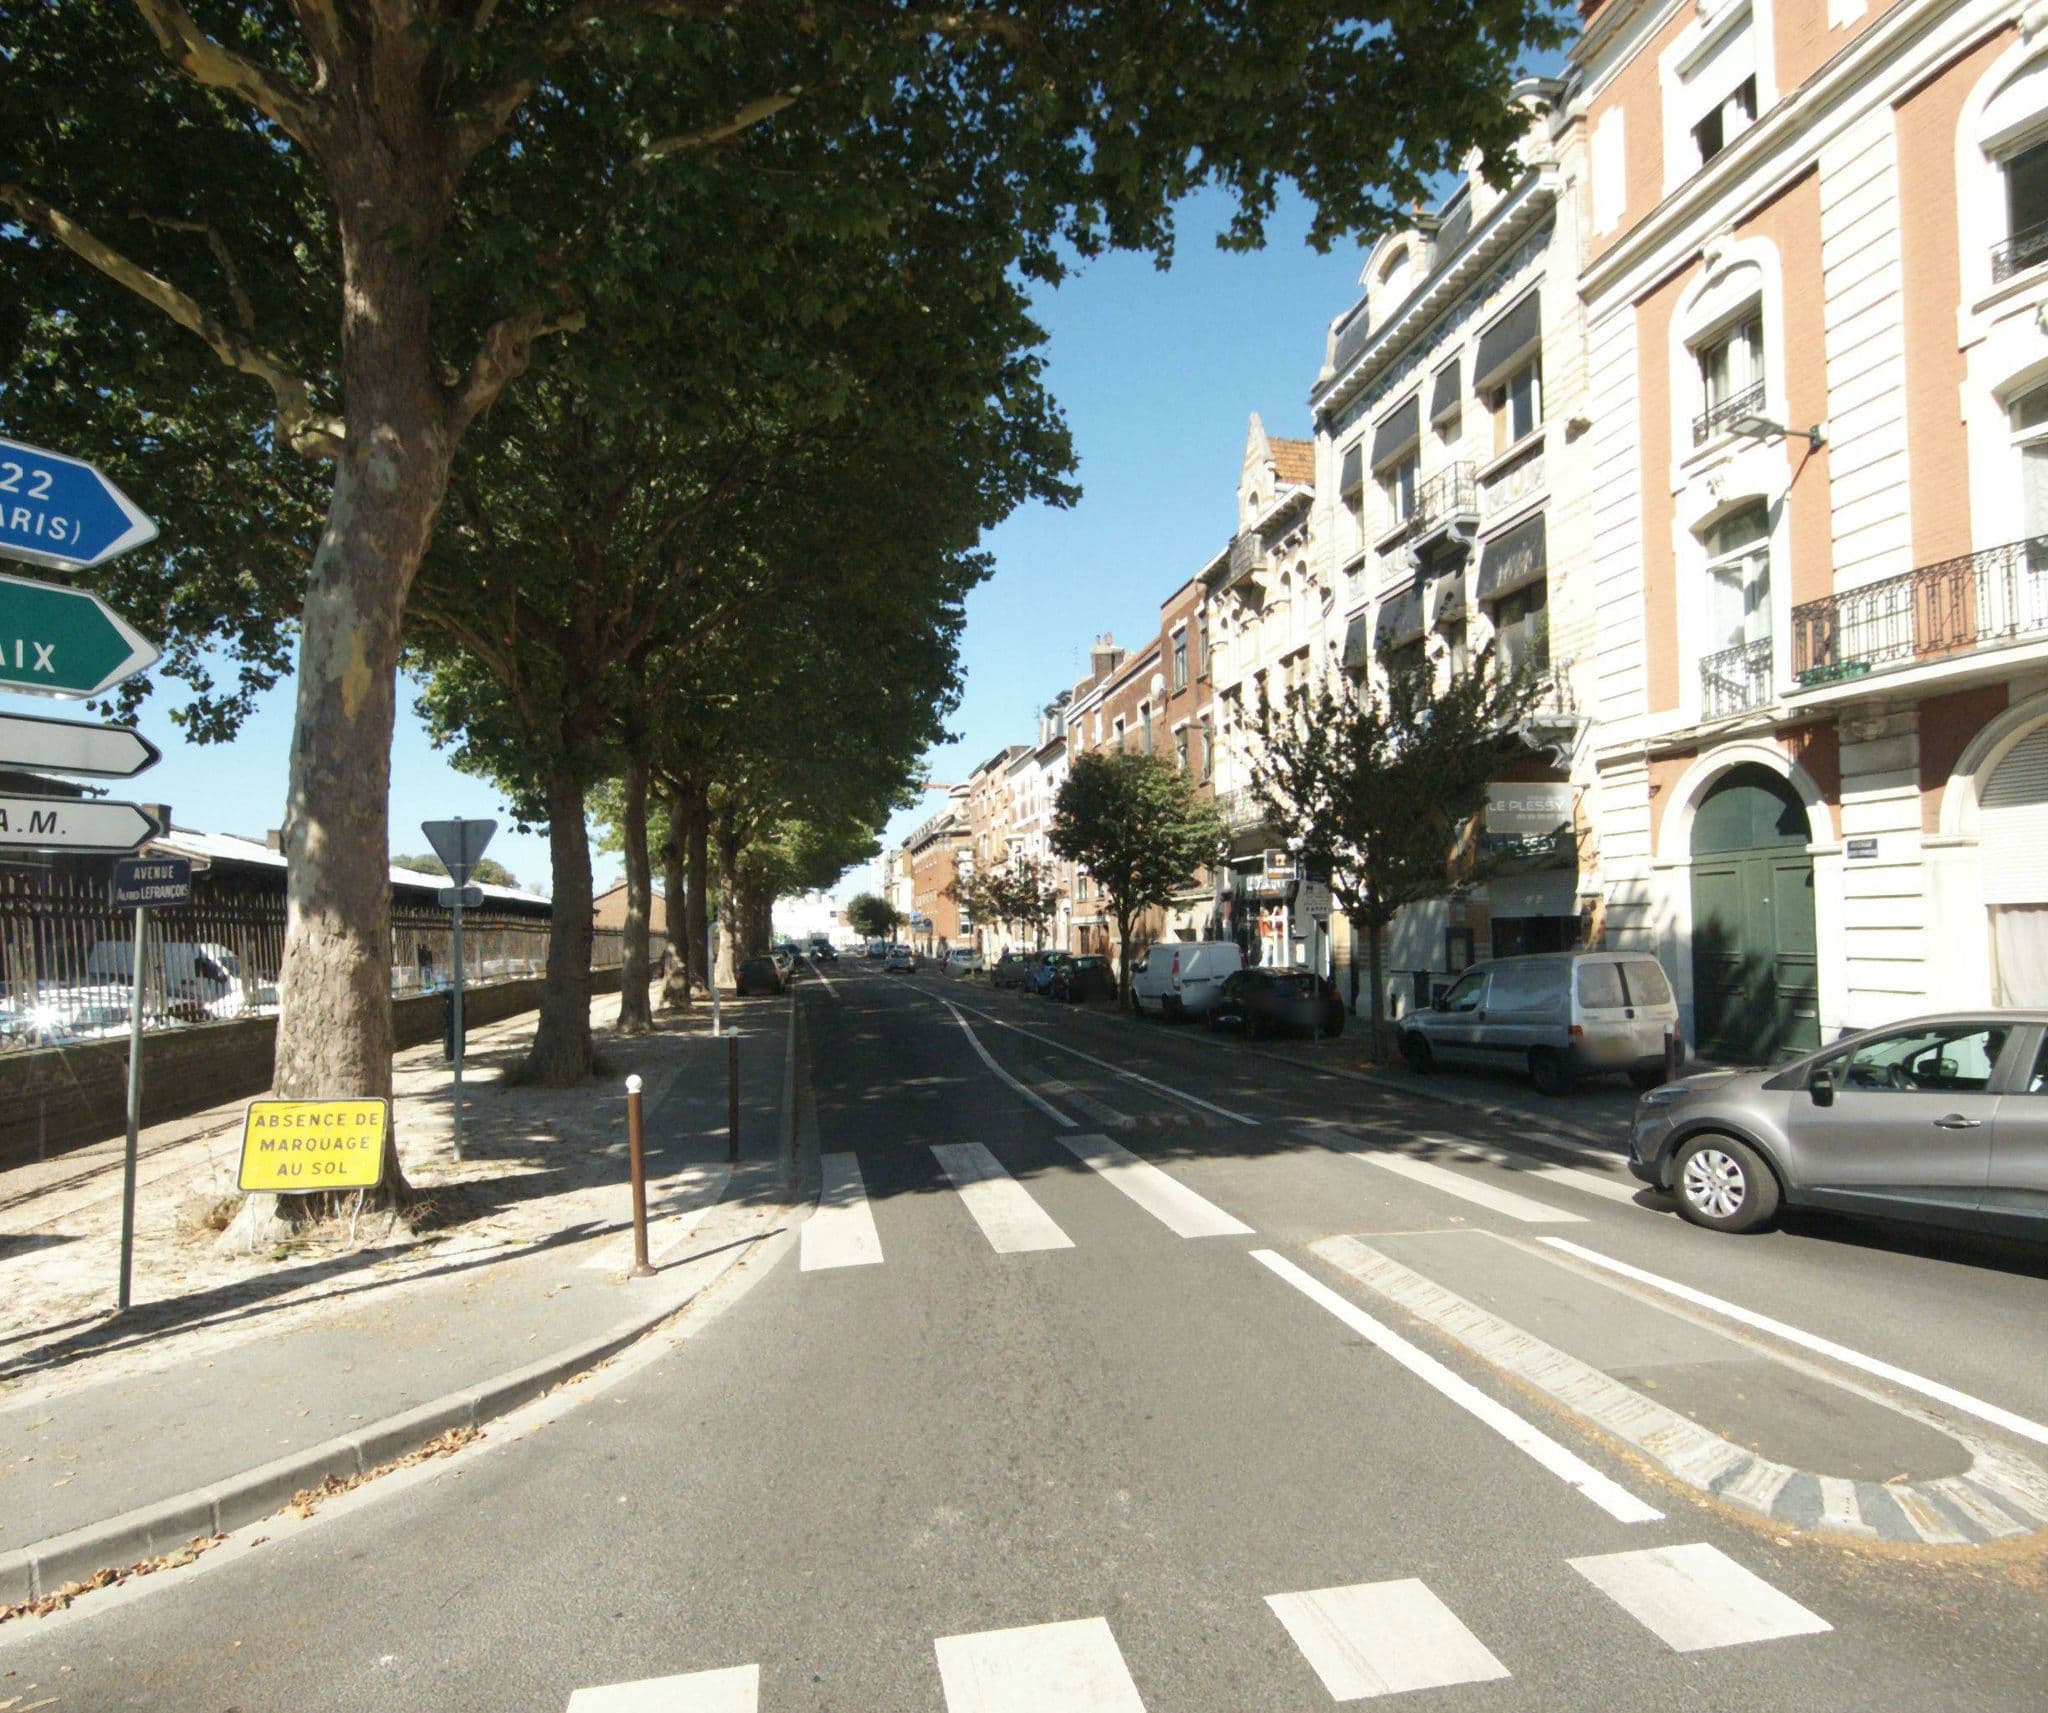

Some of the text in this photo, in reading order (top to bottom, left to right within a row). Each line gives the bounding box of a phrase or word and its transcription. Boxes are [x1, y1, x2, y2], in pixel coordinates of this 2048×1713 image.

[1489, 800, 1506, 811] LE
[133, 865, 174, 880] AVENUE
[255, 1112, 379, 1128] ABSENCE DE
[260, 1136, 370, 1152] MARQUAGE
[277, 1161, 348, 1177] AU SOL
